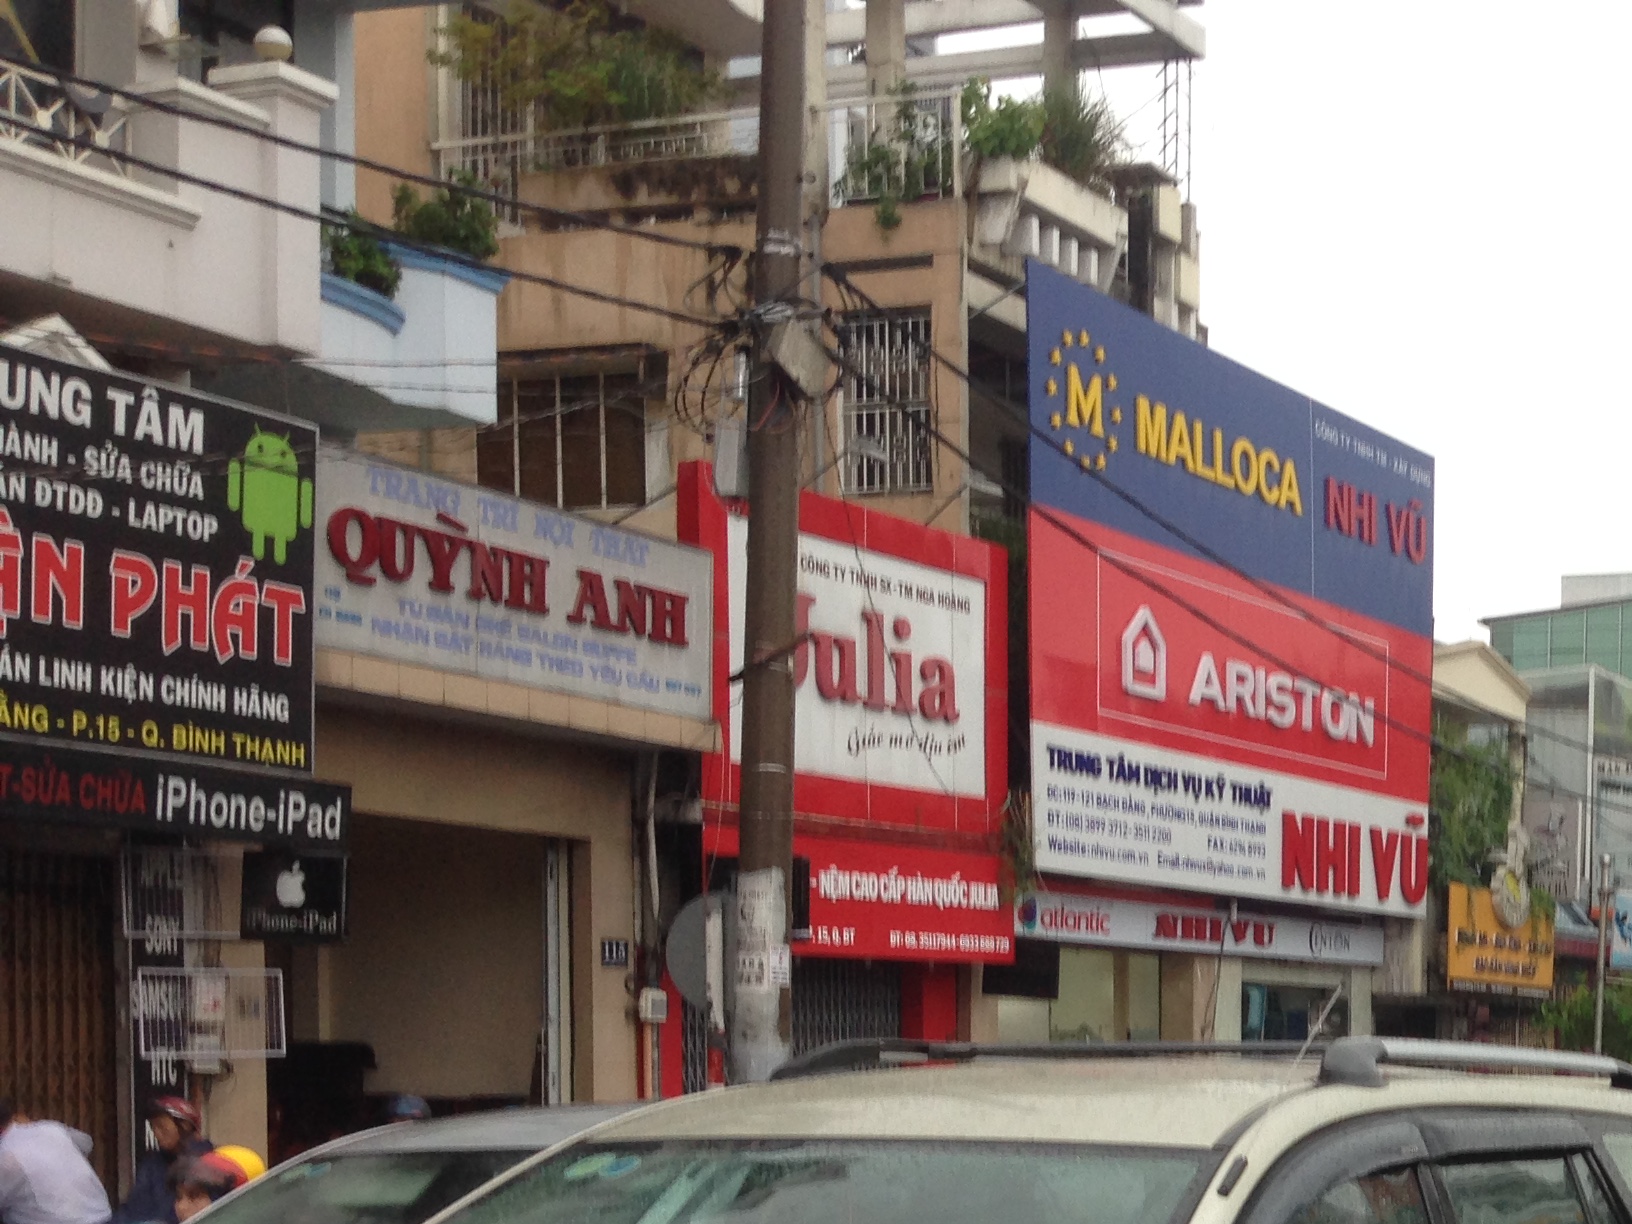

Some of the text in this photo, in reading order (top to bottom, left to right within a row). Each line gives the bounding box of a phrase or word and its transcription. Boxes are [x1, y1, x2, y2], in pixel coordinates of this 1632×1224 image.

[107, 387, 204, 455] TÂM
[1066, 362, 1104, 438] M
[84, 439, 132, 485] SỬA
[140, 460, 204, 501] CHỮA
[1135, 394, 1303, 516] MALLOCA
[128, 497, 219, 543] LAPTOP
[1324, 475, 1427, 565] NHI VŨ
[110, 548, 306, 667] PHÁT
[327, 507, 689, 648] QUỲNH ANH
[39, 654, 92, 694] LINH
[100, 664, 154, 705] KIỆN
[161, 673, 226, 713] CHÍNH
[233, 684, 290, 724] HÃNG
[1189, 650, 1375, 747] ARISTON
[172, 721, 226, 756] BÌNH
[232, 733, 306, 768] THẠNH
[1047, 743, 1102, 780] TRUNG
[1106, 751, 1141, 787] TÂM
[851, 870, 878, 902] CAO
[1281, 810, 1361, 898] NHI
[1369, 813, 1428, 905] VŨ
[145, 913, 180, 955] SONY
[1041, 903, 1110, 936] atlantic
